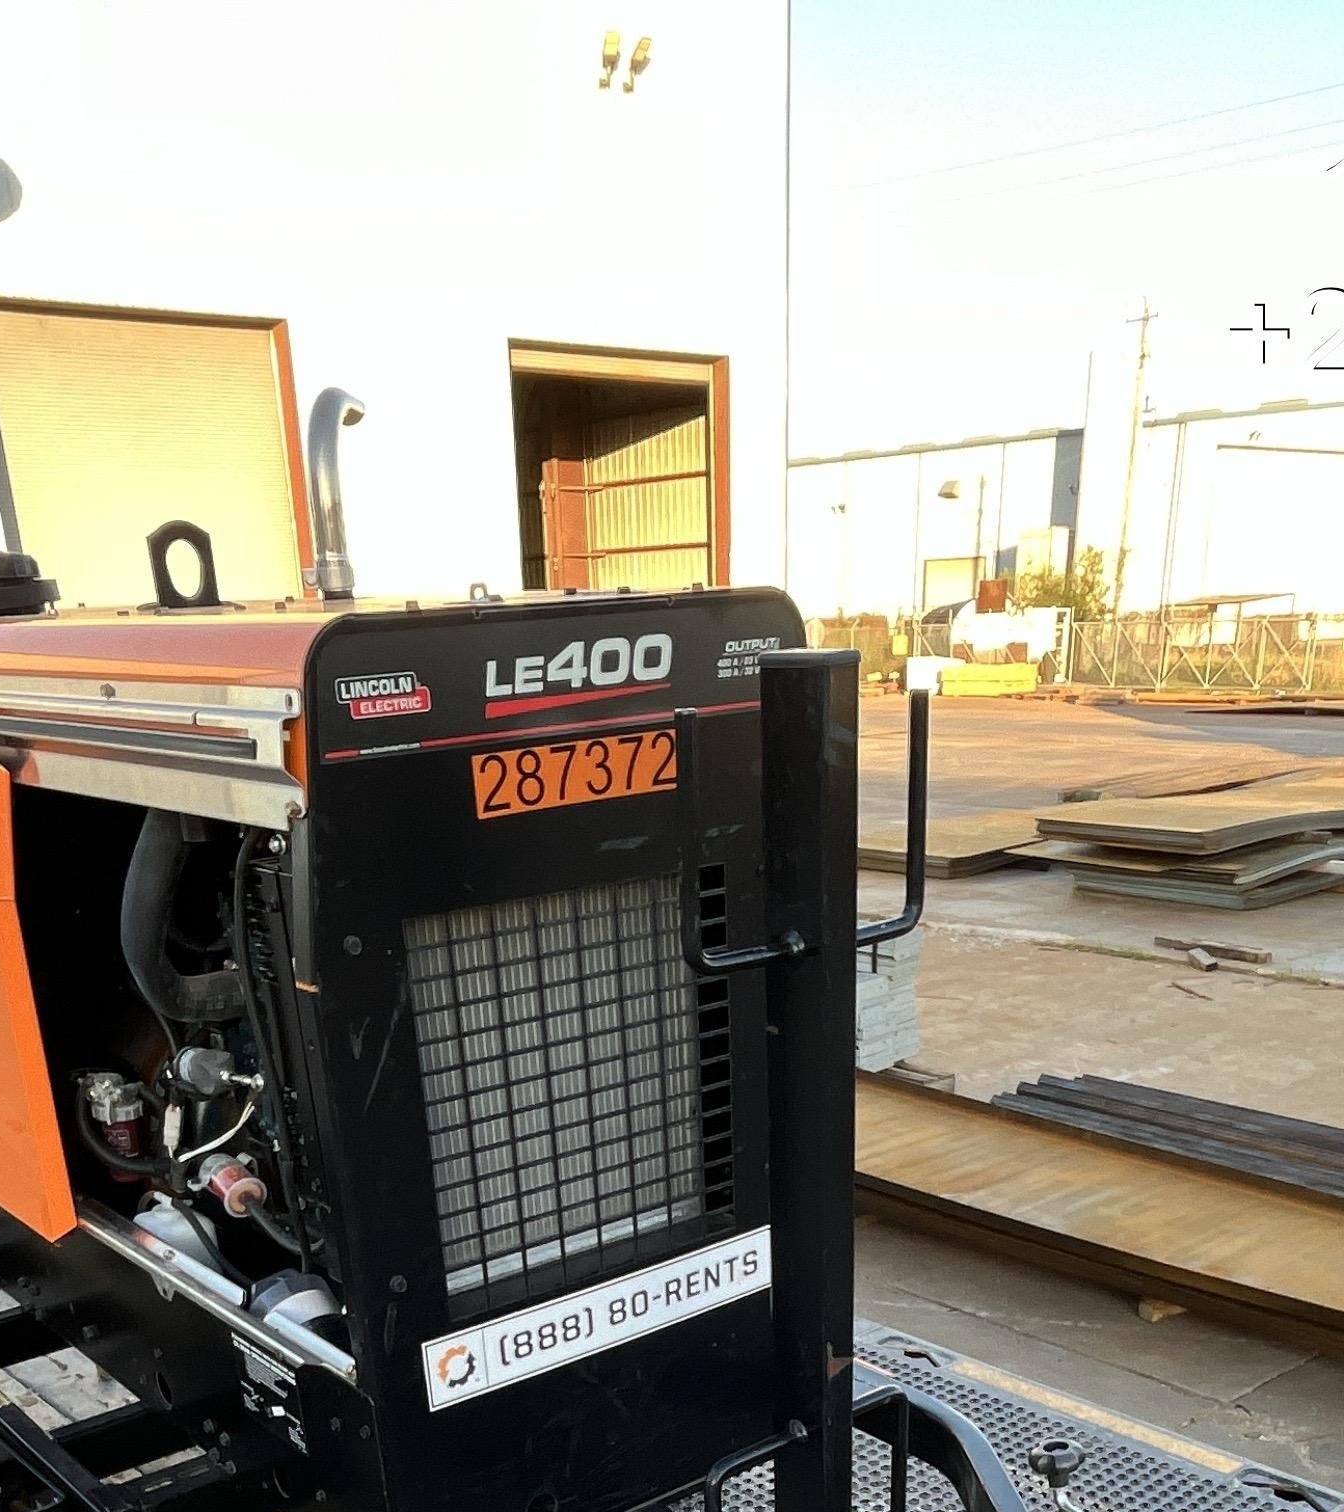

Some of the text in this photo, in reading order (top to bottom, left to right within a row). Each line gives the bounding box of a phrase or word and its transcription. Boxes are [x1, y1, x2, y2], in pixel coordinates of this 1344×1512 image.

[485, 633, 673, 698] LE400
[724, 636, 778, 653] OUTPUT
[340, 676, 413, 699] LINCOLN
[359, 695, 423, 714] ELECTRIC
[478, 730, 677, 814] 287372
[499, 1249, 759, 1366] (888) 80-RENTS
